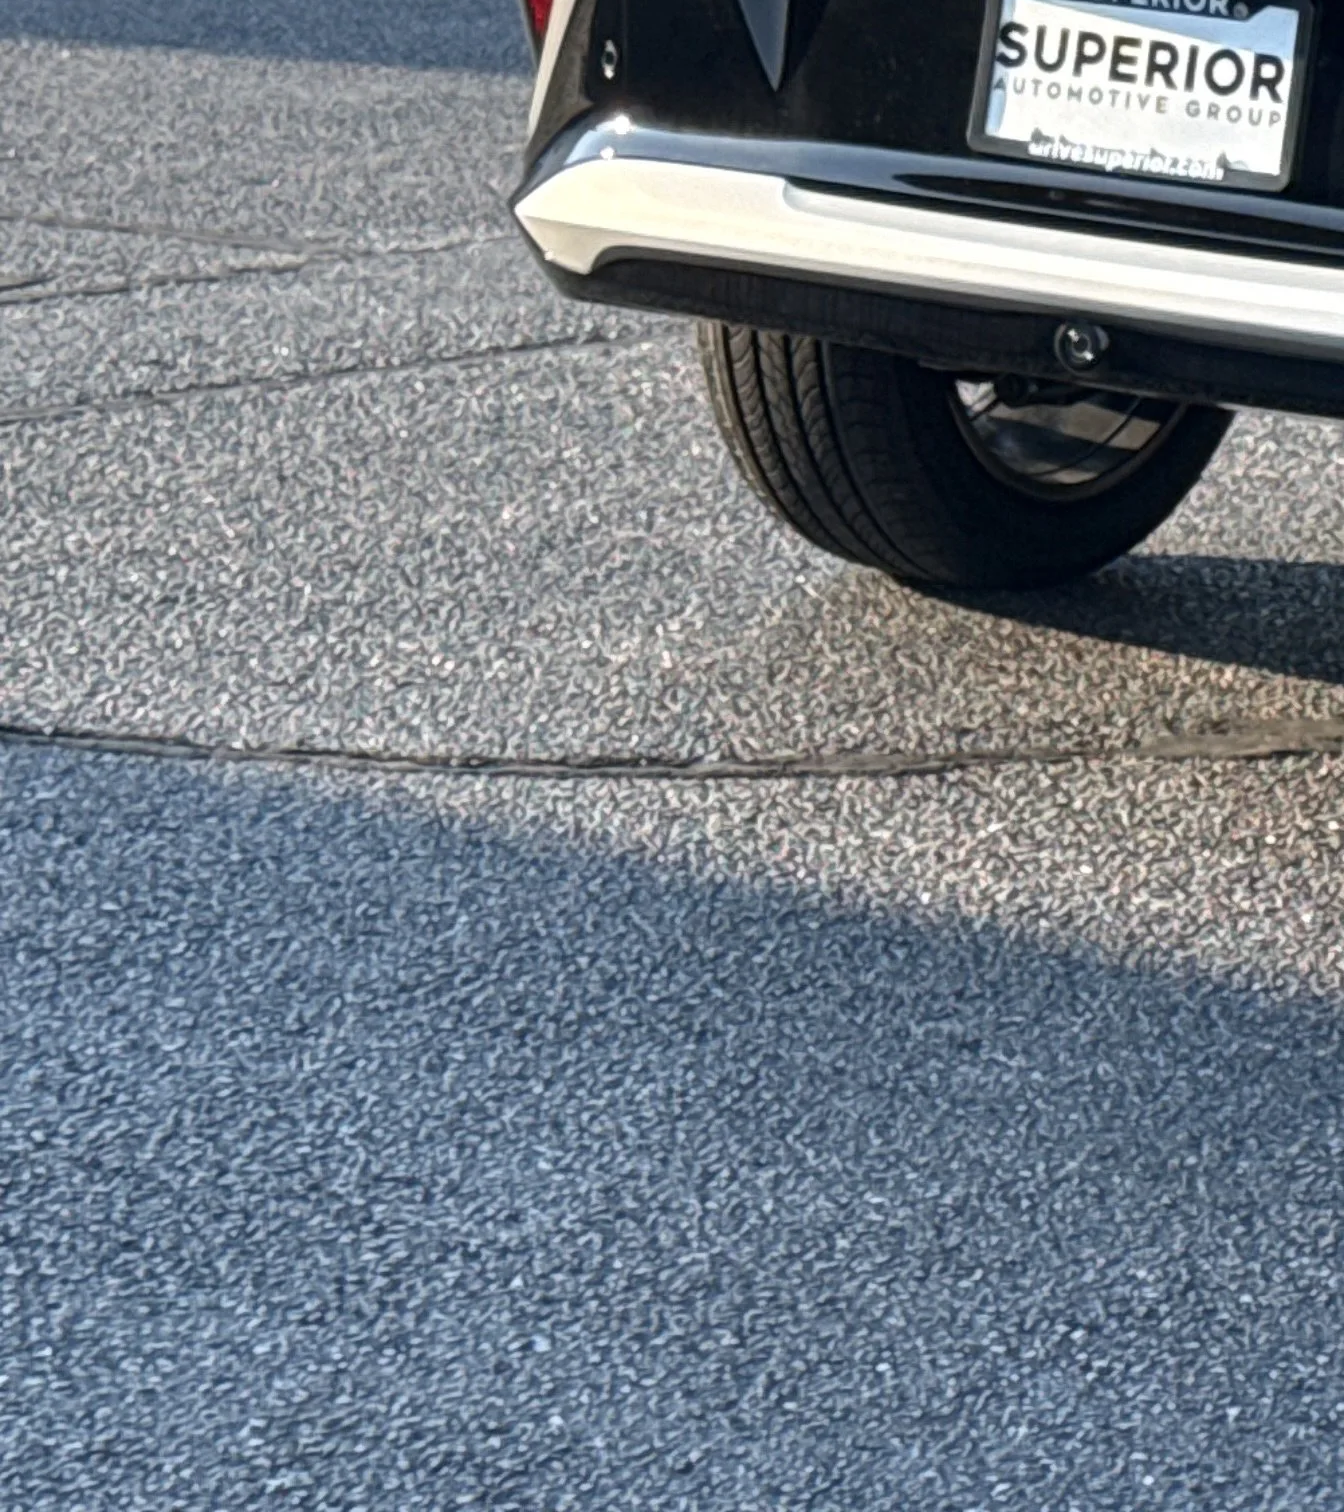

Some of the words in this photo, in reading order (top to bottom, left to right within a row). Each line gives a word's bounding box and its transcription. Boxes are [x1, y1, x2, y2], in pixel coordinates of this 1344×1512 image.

[995, 21, 1286, 104] SUPERIOR
[993, 76, 1169, 114] AUTOMOTIVE
[1185, 99, 1282, 129] GROUP
